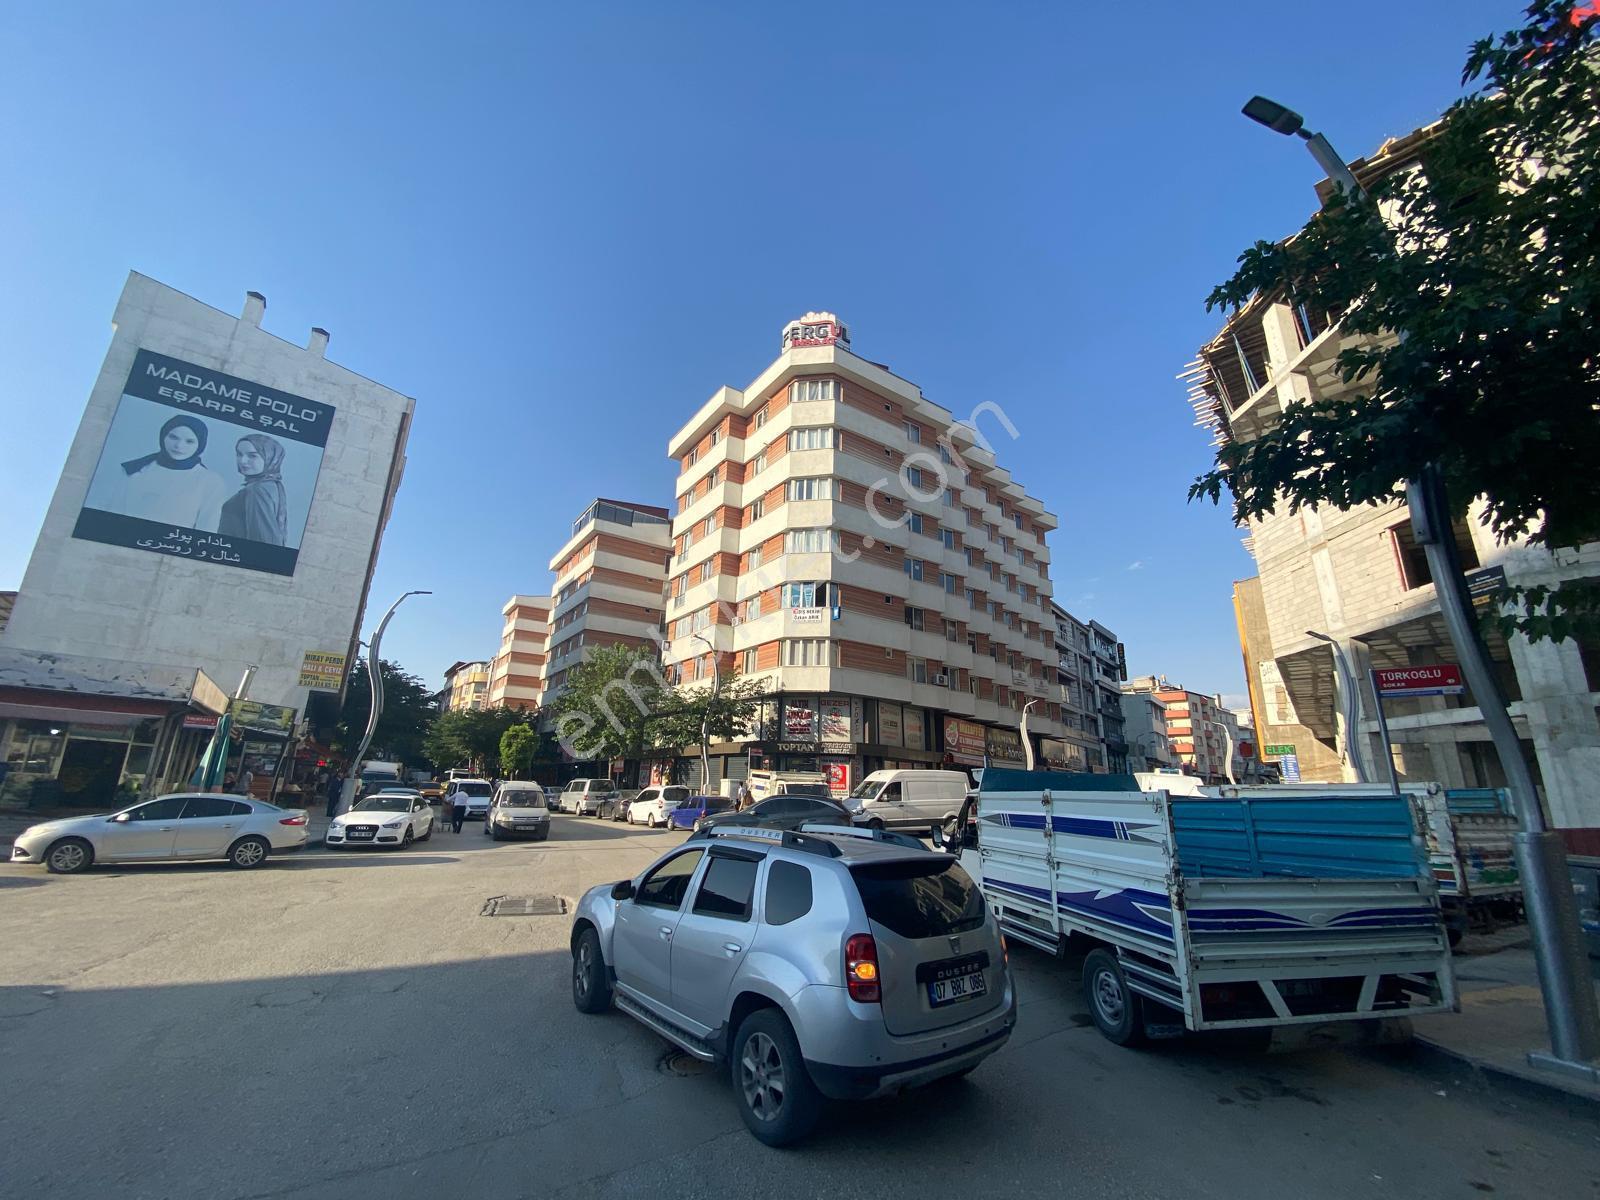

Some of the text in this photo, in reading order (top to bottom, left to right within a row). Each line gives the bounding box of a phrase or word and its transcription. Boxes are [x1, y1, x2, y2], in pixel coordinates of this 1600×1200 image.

[146, 362, 318, 423] MADAME POLO
[158, 385, 301, 434] EŞARP & ŞAL
[163, 528, 232, 549] مادام پولو
[136, 538, 241, 563] شال و روسری
[777, 743, 815, 752] TOPTAN
[740, 828, 781, 839] DUSTER
[937, 962, 981, 979] DUSTER
[935, 983, 946, 1000] 07
